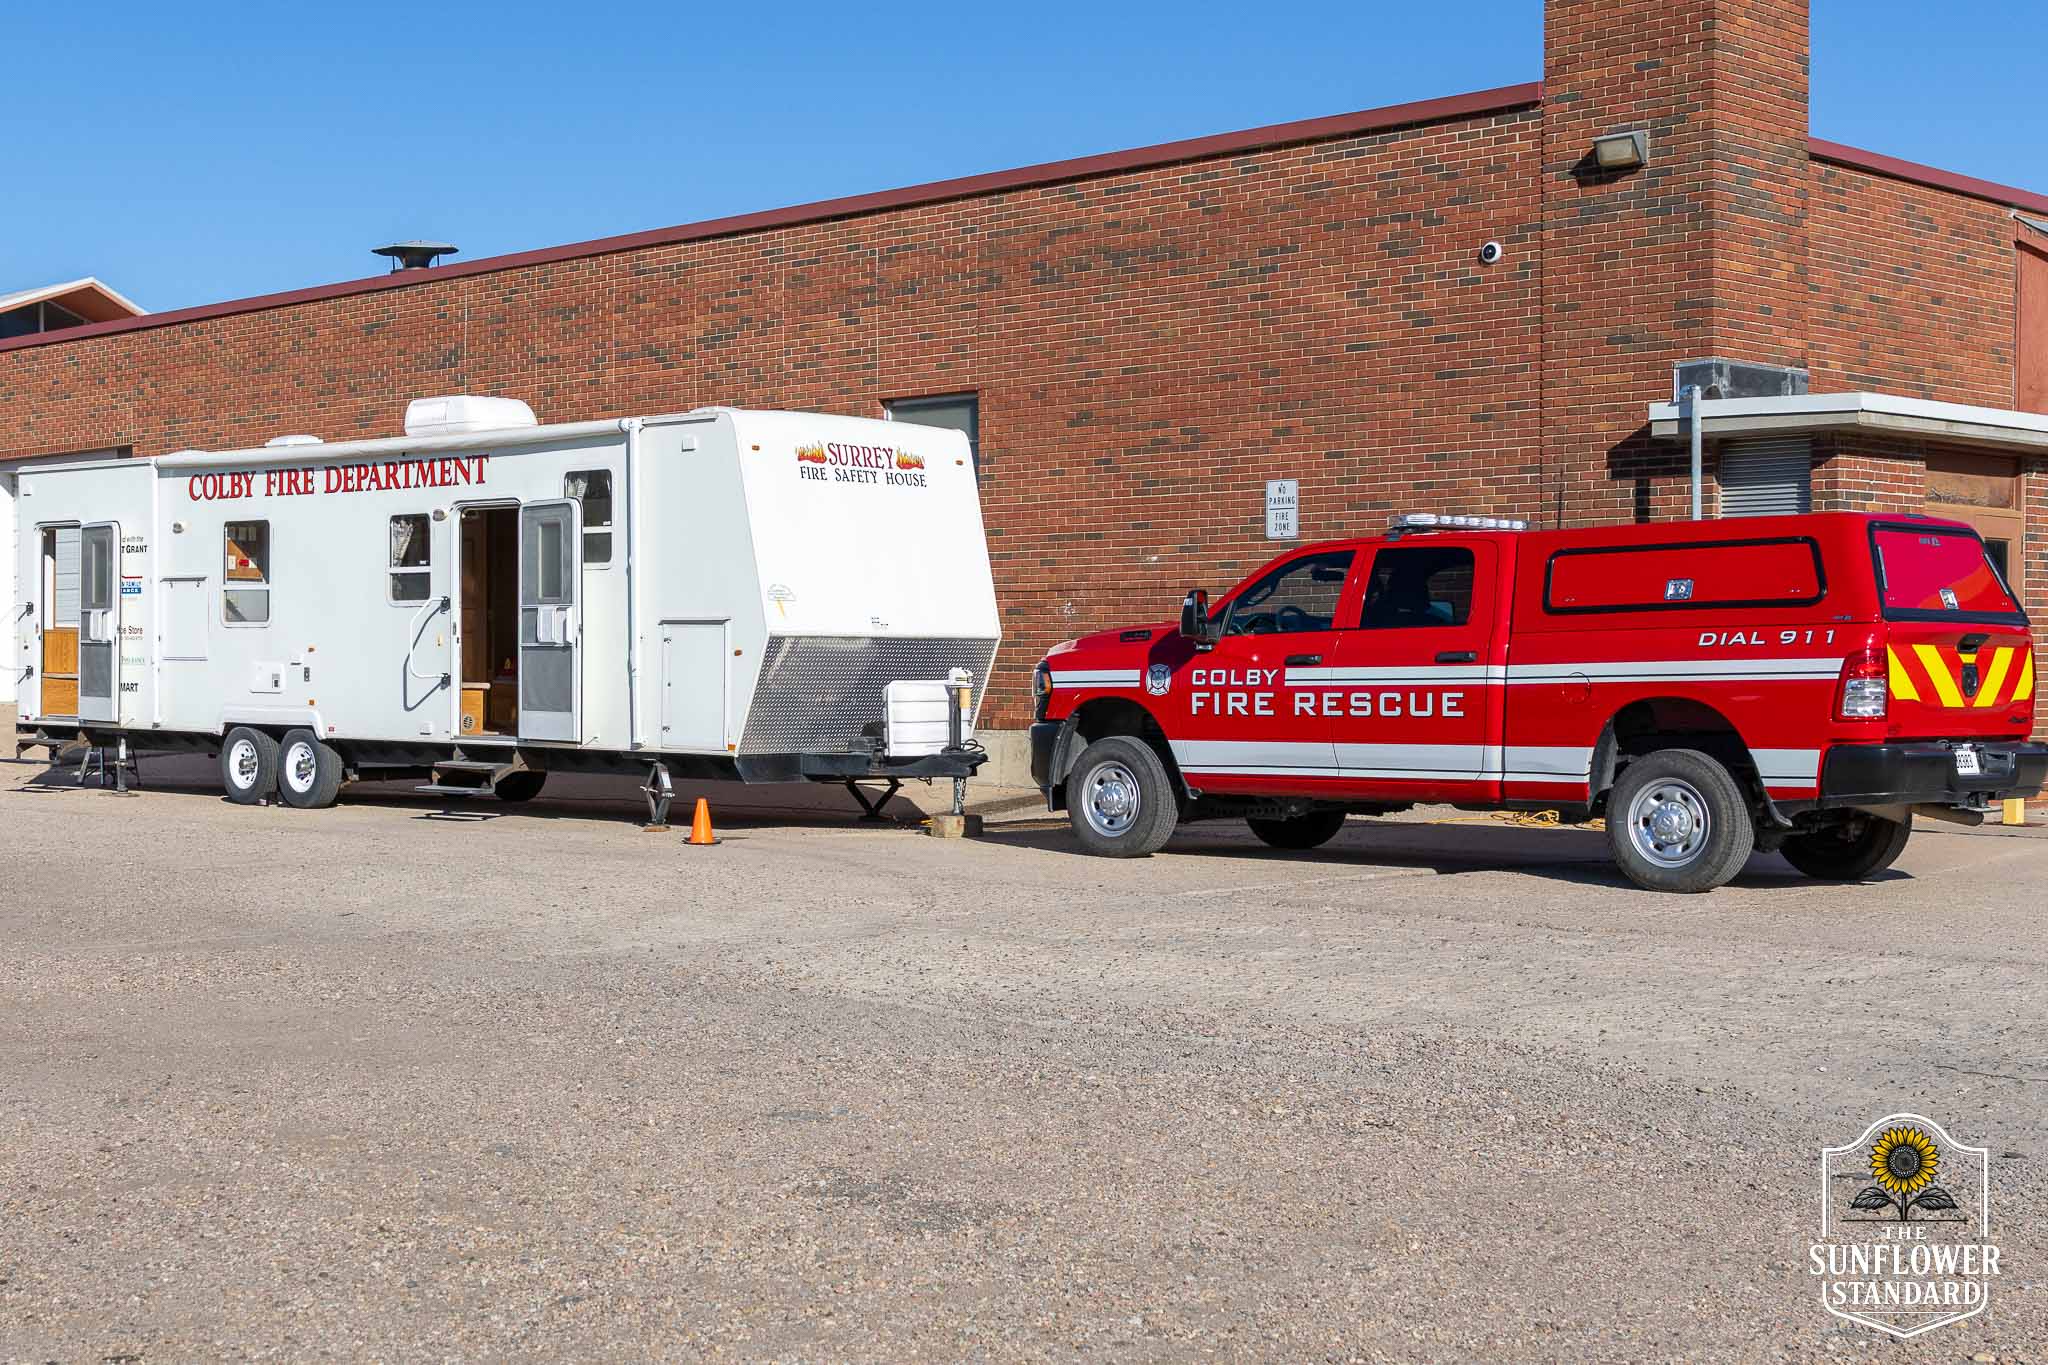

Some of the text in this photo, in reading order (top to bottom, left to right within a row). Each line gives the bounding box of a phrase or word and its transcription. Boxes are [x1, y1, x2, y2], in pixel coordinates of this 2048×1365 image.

[827, 442, 894, 469] SURREY
[188, 454, 490, 501] COLBY FIRE DEPARTMENT
[800, 466, 927, 488] FIRE SAFETY HOUSE
[1277, 485, 1287, 495] NO
[1268, 495, 1296, 505] PARKING
[1275, 511, 1289, 521] FIRE
[1274, 522, 1290, 532] ZONE
[126, 544, 148, 554] GRANT
[1698, 629, 1835, 647] DIAL 911
[1191, 668, 1279, 686] COLBY
[1191, 691, 1466, 717] FIRE RESCUE
